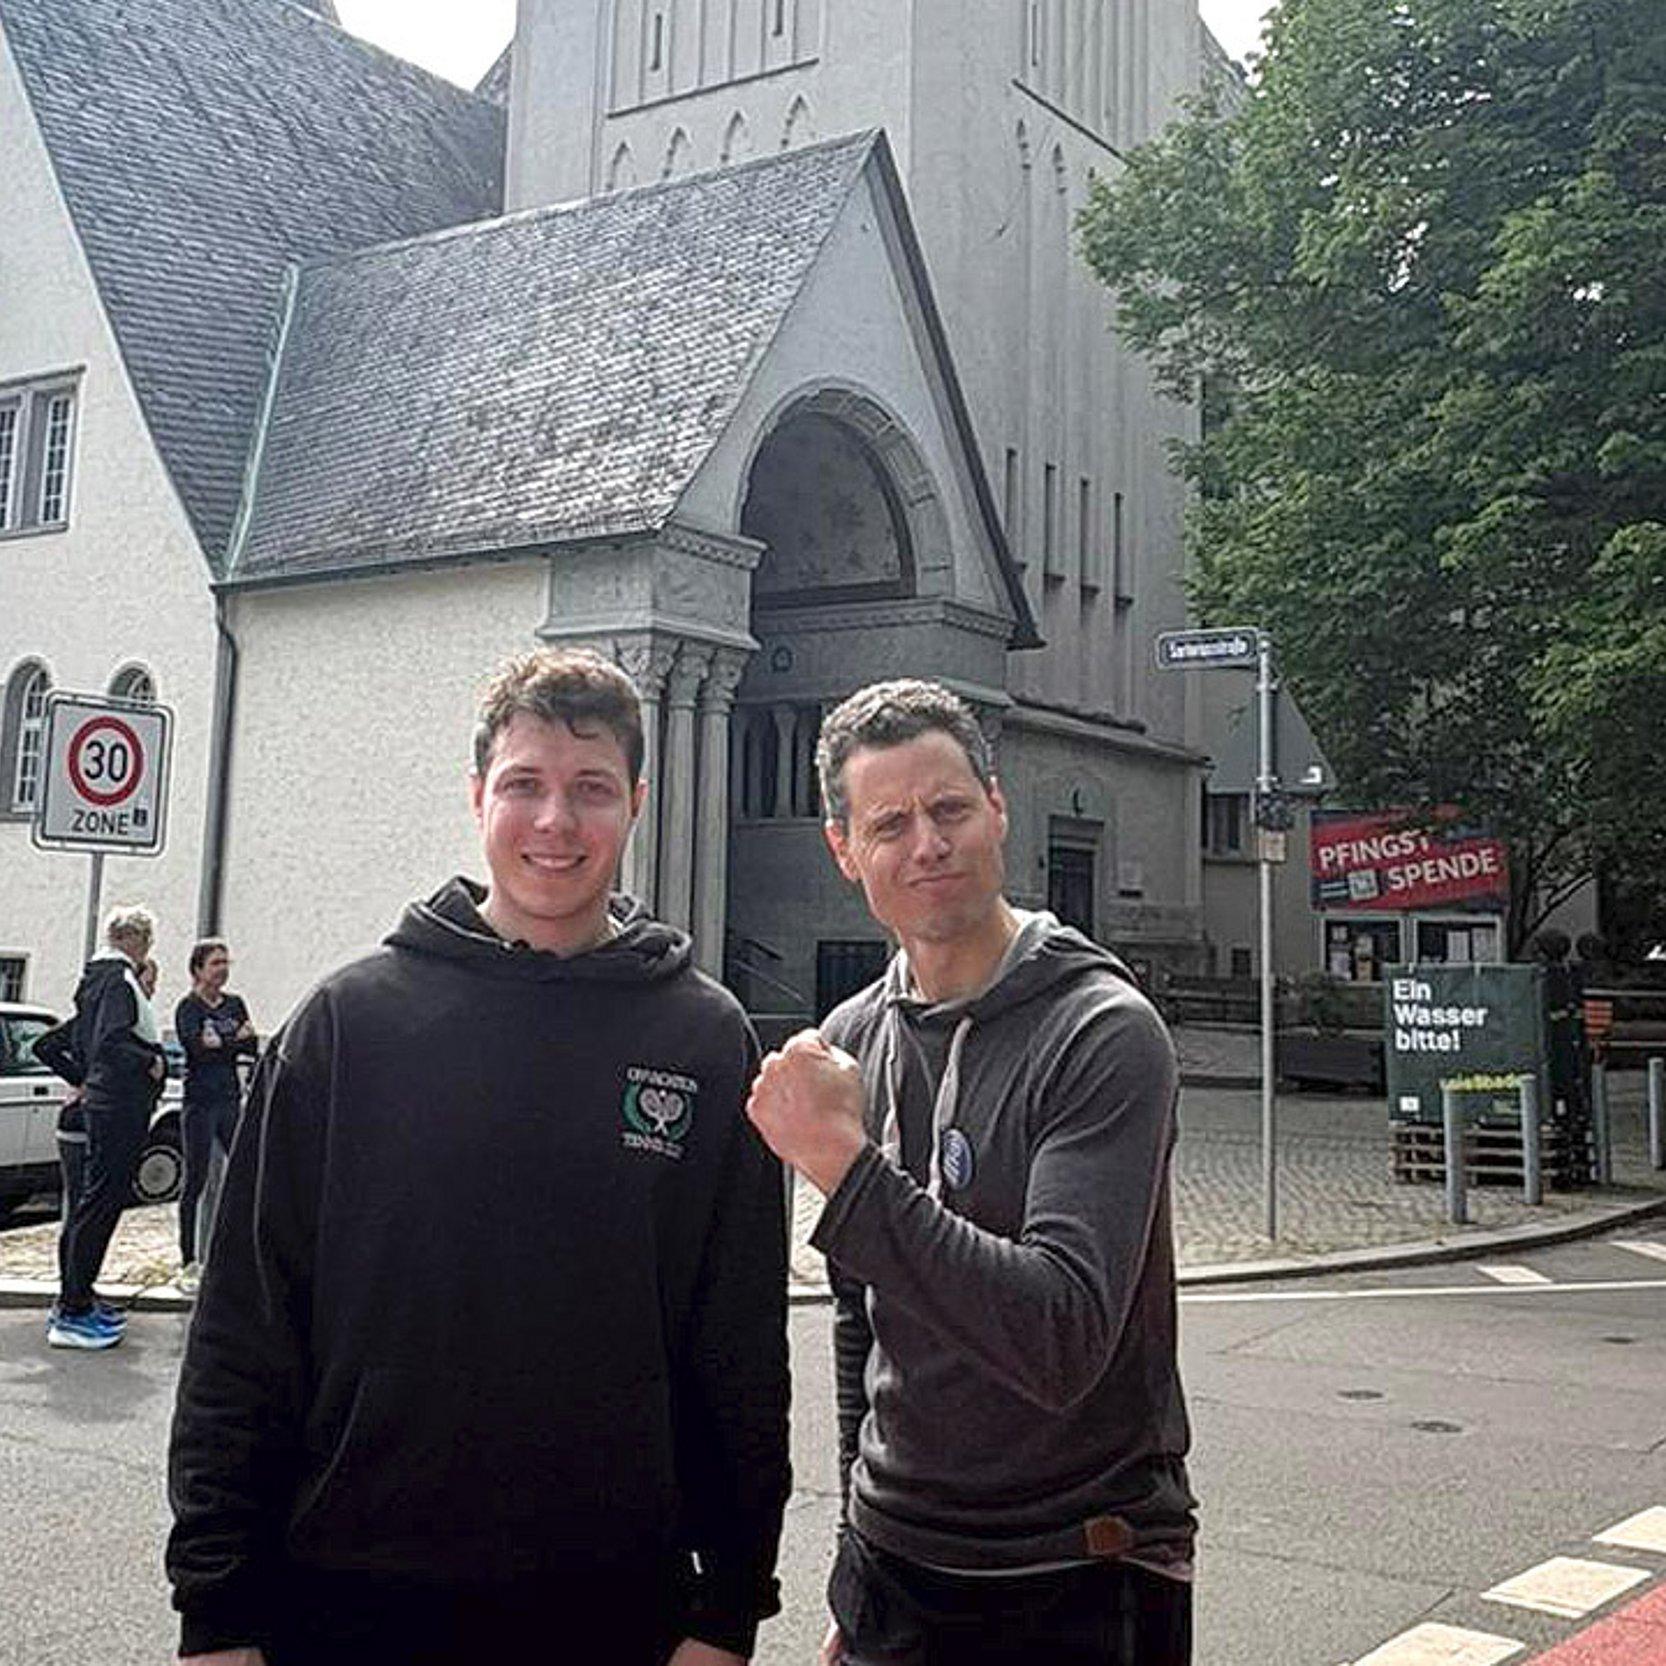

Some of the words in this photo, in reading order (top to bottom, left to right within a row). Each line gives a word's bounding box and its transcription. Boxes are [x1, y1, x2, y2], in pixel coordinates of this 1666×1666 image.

[83, 740, 128, 783] 30
[71, 809, 130, 835] ZONE
[1387, 848, 1499, 890] SPENDE
[1393, 978, 1432, 1001] Ein
[1392, 1003, 1488, 1026] Wasser
[1395, 1028, 1461, 1051] bitte!
